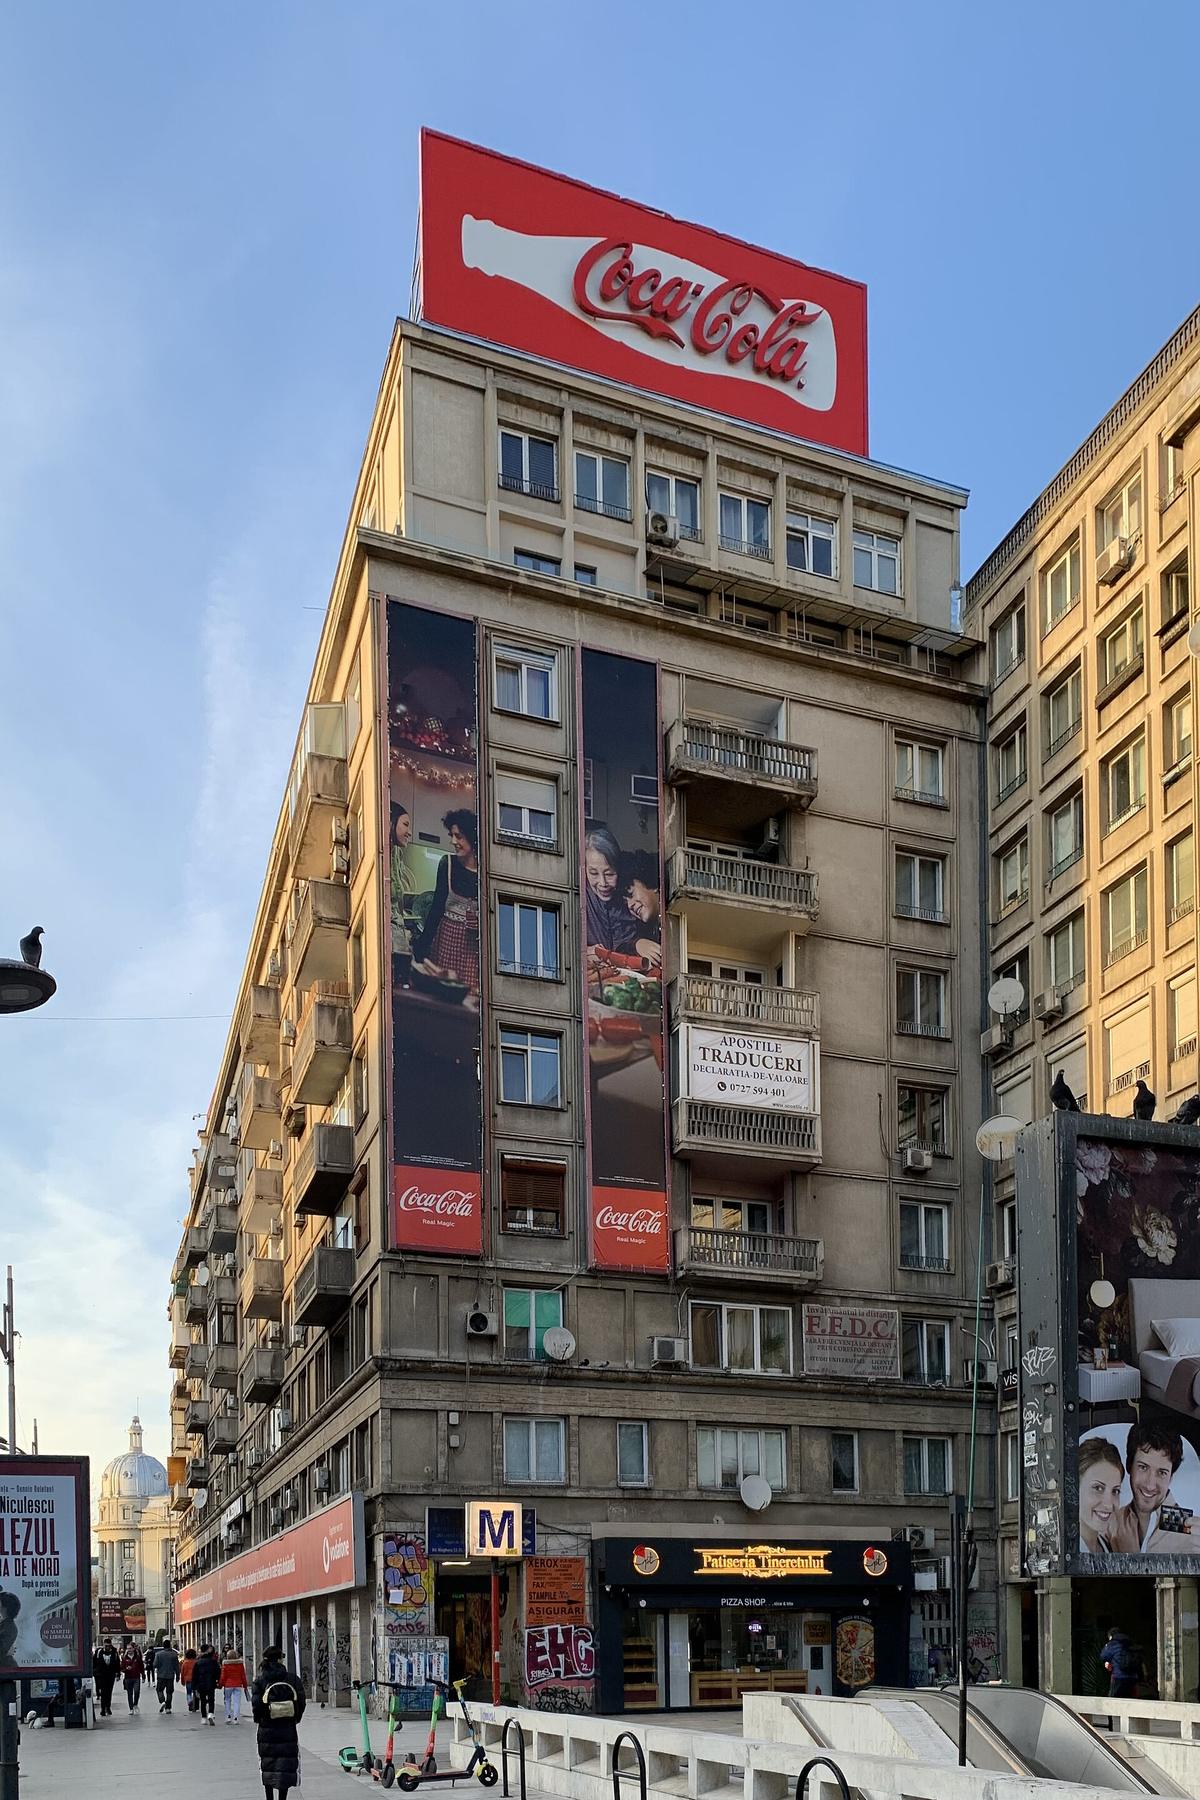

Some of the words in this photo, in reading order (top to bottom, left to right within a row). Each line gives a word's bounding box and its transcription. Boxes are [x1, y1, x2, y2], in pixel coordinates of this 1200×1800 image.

[573, 241, 824, 383] Coca-Cola
[720, 1036, 782, 1053] APOSTILE
[698, 1046, 802, 1072] TRADUCERI
[693, 1063, 809, 1085] DECLARATIA-DE-VALOARE
[730, 1083, 751, 1093] 0727
[752, 1086, 768, 1096] 594
[770, 1087, 785, 1097] 401
[400, 1186, 478, 1217] Coca-Cola
[422, 1218, 435, 1227] Real
[436, 1219, 455, 1228] Magic
[595, 1205, 667, 1234] Coca-Cola
[629, 1237, 647, 1245] Magic
[806, 1315, 896, 1338] F.F.D.C.
[0, 1495, 55, 1514] Niculescu
[478, 1509, 515, 1549] M
[0, 1557, 10, 1577] A
[14, 1557, 27, 1577] DE
[31, 1557, 60, 1577] NORD
[528, 1558, 559, 1568] XEROX
[702, 1554, 757, 1569] Patiseria
[758, 1554, 825, 1569] Tineretului
[532, 1581, 545, 1589] FAX
[528, 1591, 557, 1600] STAMPILE
[720, 1598, 743, 1606] PIZZA
[744, 1598, 766, 1606] SHOP
[528, 1606, 584, 1616] ASIGURARI
